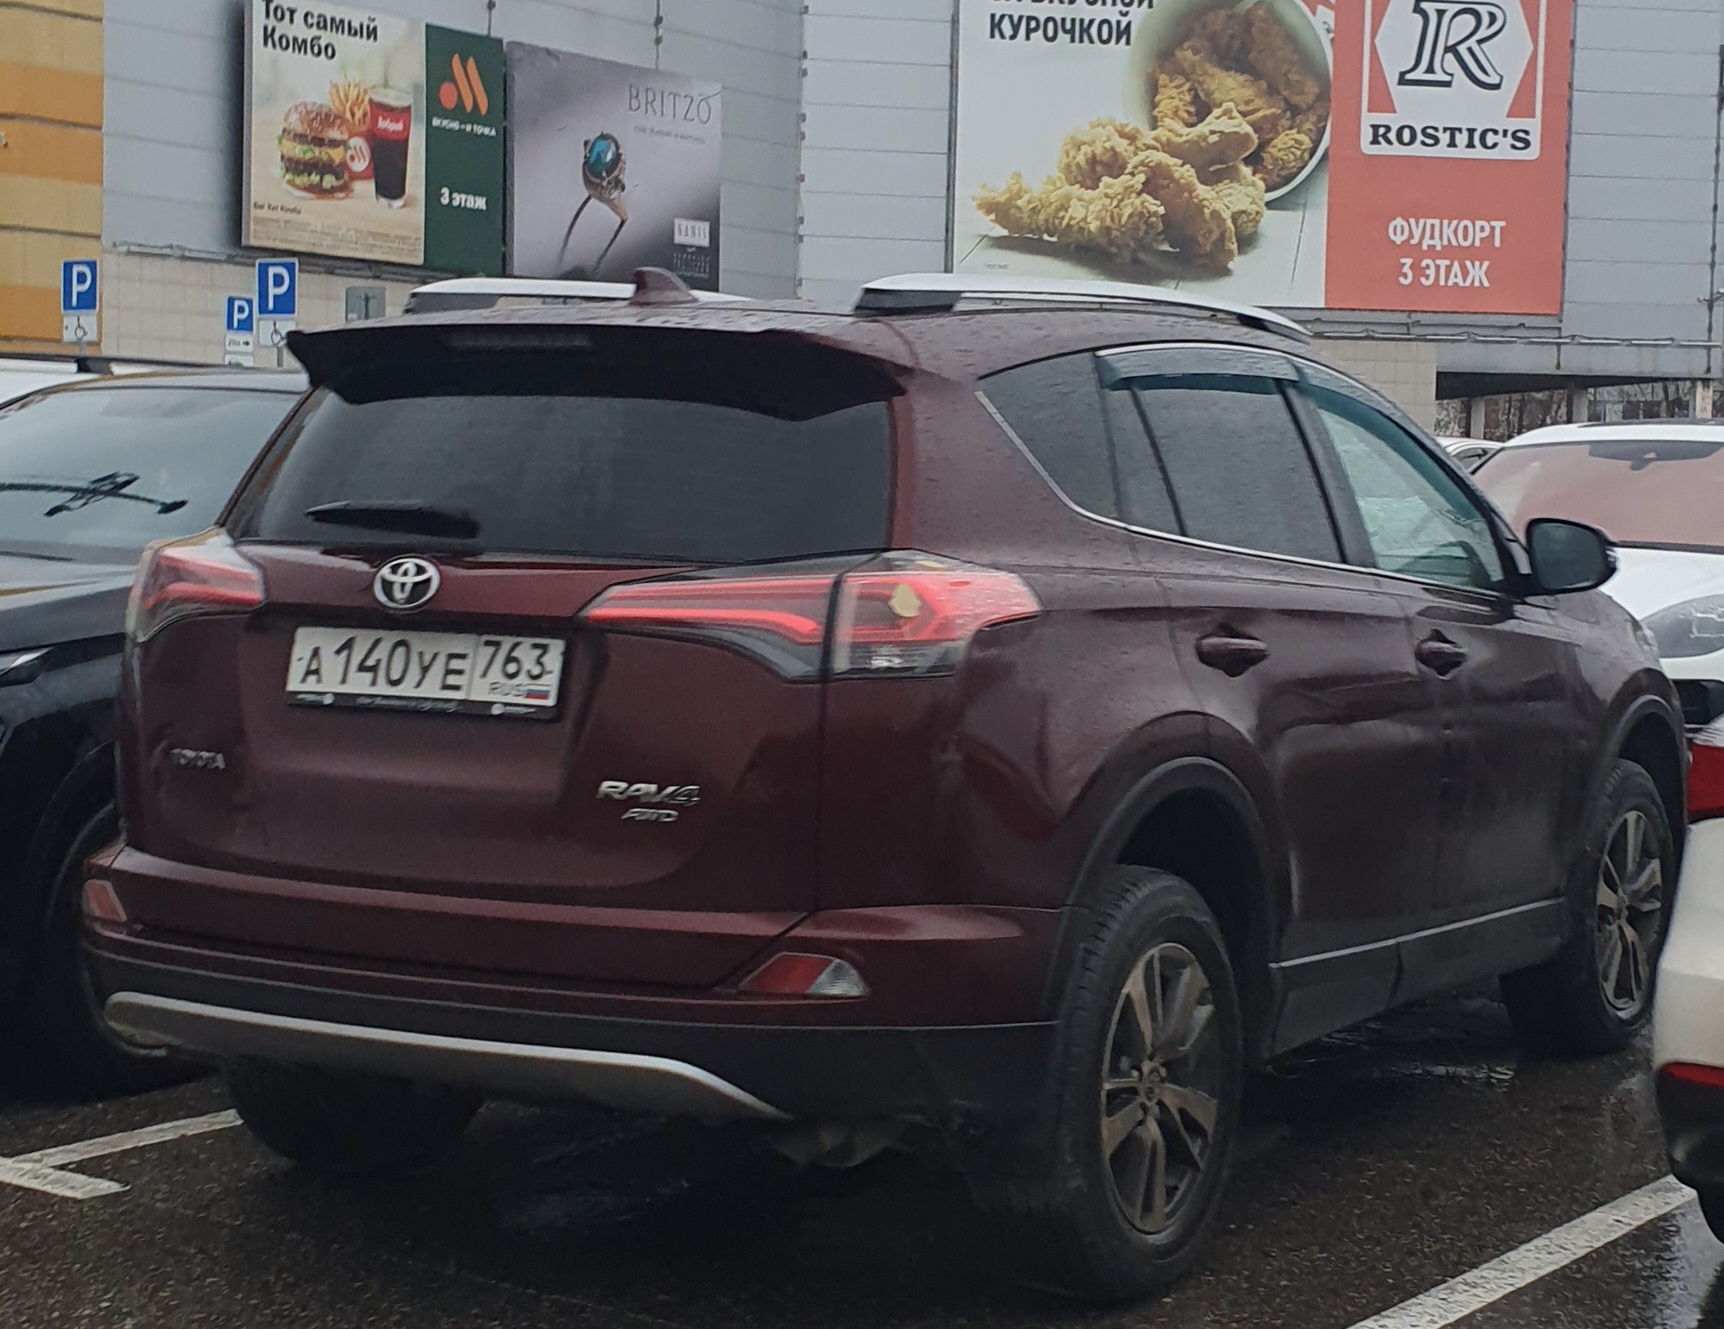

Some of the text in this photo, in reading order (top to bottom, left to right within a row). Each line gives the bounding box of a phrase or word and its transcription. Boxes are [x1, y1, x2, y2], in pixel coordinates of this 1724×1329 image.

[262, 0, 378, 42] Тот самый
[989, 10, 1132, 46] КУРОЧКОЙ
[263, 24, 336, 60] Комбо
[1369, 124, 1532, 151] ROSTIC'S
[440, 186, 487, 211] 3 этаж
[1388, 217, 1506, 250] ФУДКОРТ
[71, 264, 92, 307] P
[267, 265, 290, 310] P
[1398, 258, 1491, 288] 3 ЭТАЖ
[233, 300, 249, 329] P
[479, 640, 550, 680] 763
